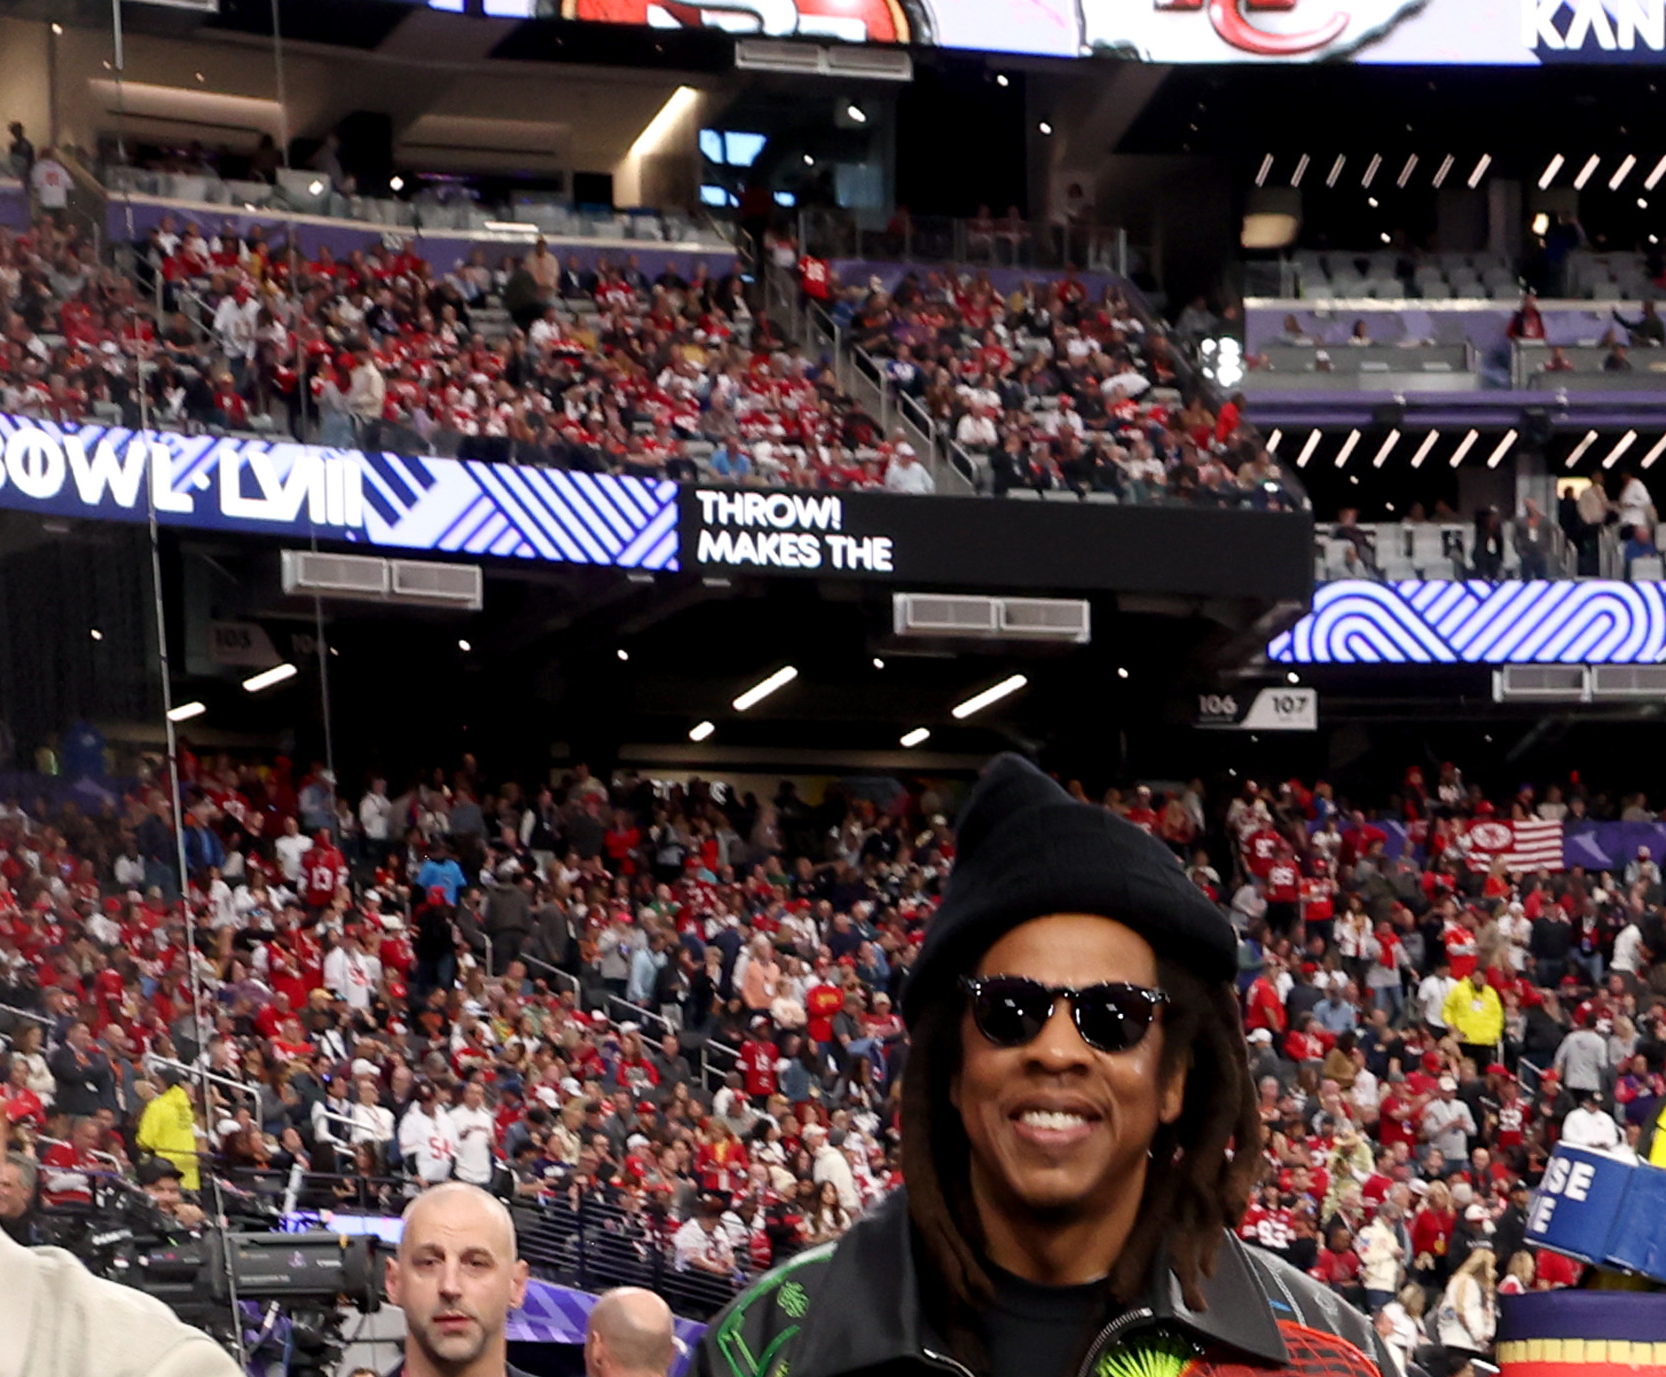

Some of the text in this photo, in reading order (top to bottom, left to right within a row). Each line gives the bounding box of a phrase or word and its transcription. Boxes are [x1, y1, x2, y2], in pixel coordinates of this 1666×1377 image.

[219, 448, 363, 528] LVIII
[695, 489, 842, 531] THROW!
[697, 529, 894, 572] MAKES THE
